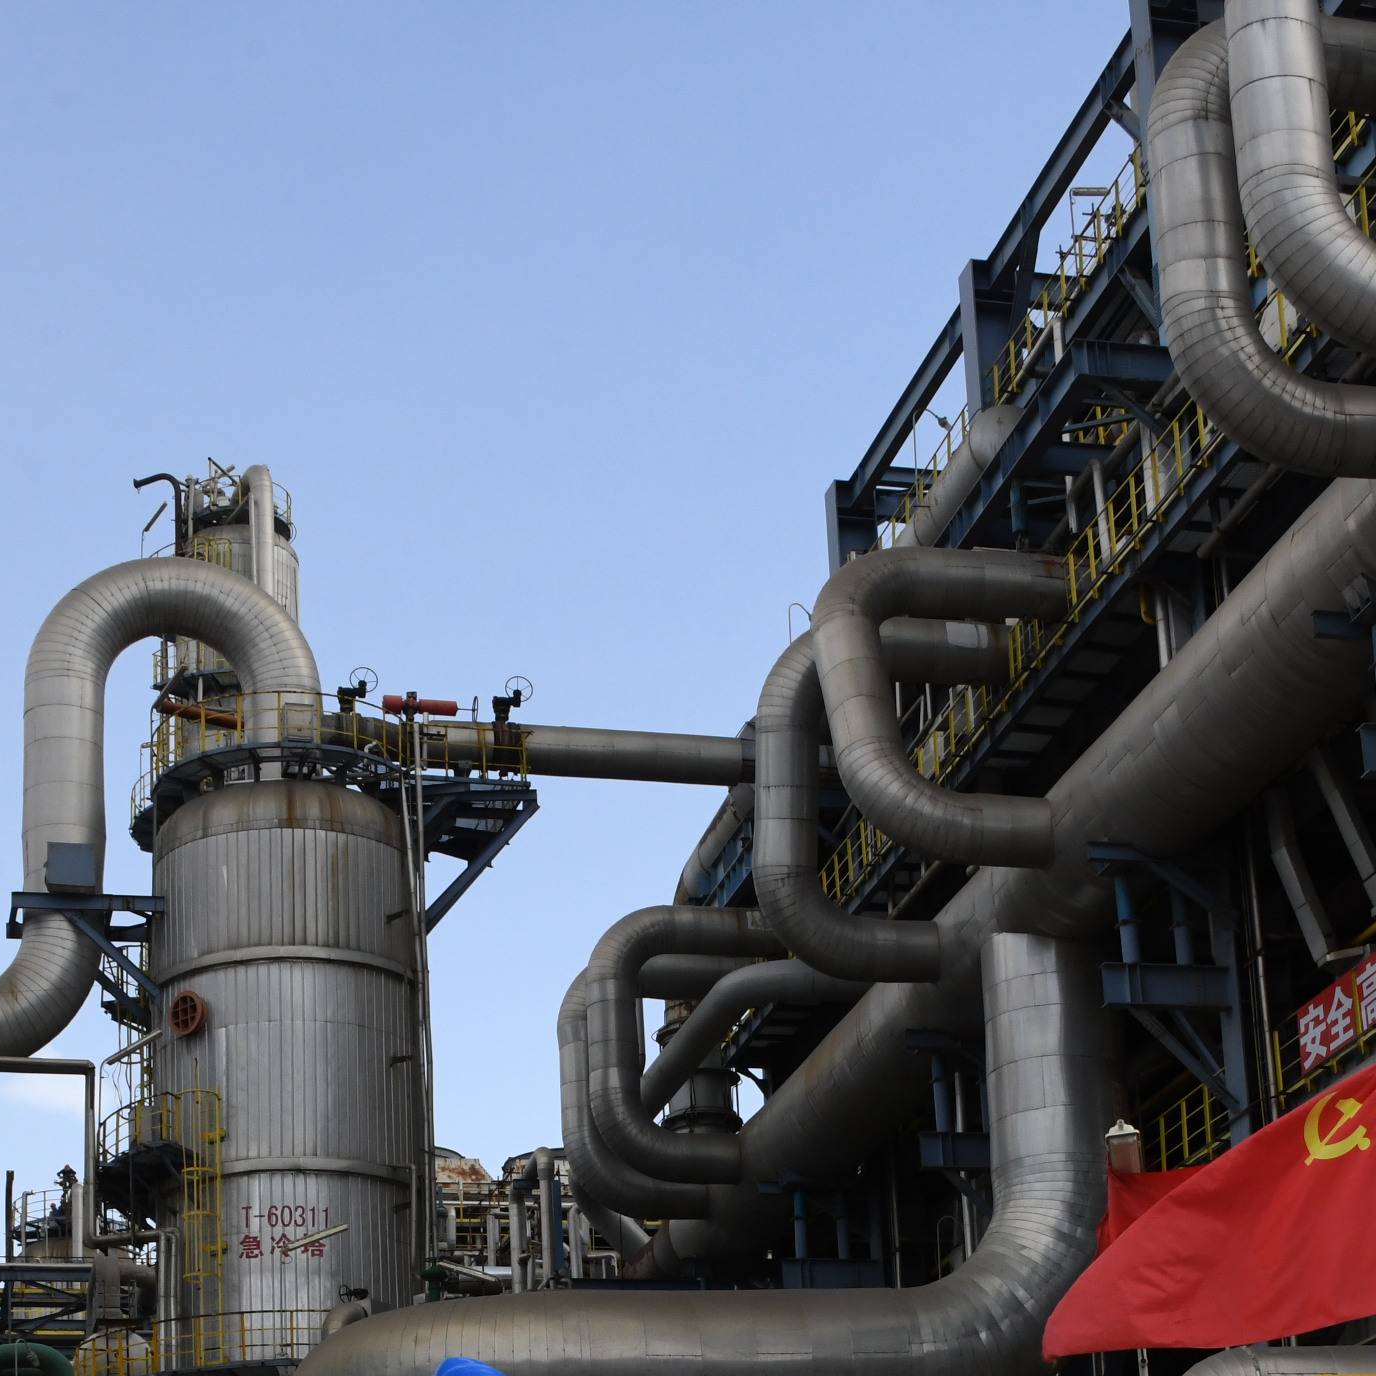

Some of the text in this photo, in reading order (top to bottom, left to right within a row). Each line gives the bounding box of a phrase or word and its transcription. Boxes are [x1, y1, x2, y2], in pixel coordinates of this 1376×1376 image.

[240, 1204, 329, 1228] T-60311
[238, 1231, 326, 1259] 急冷塔
